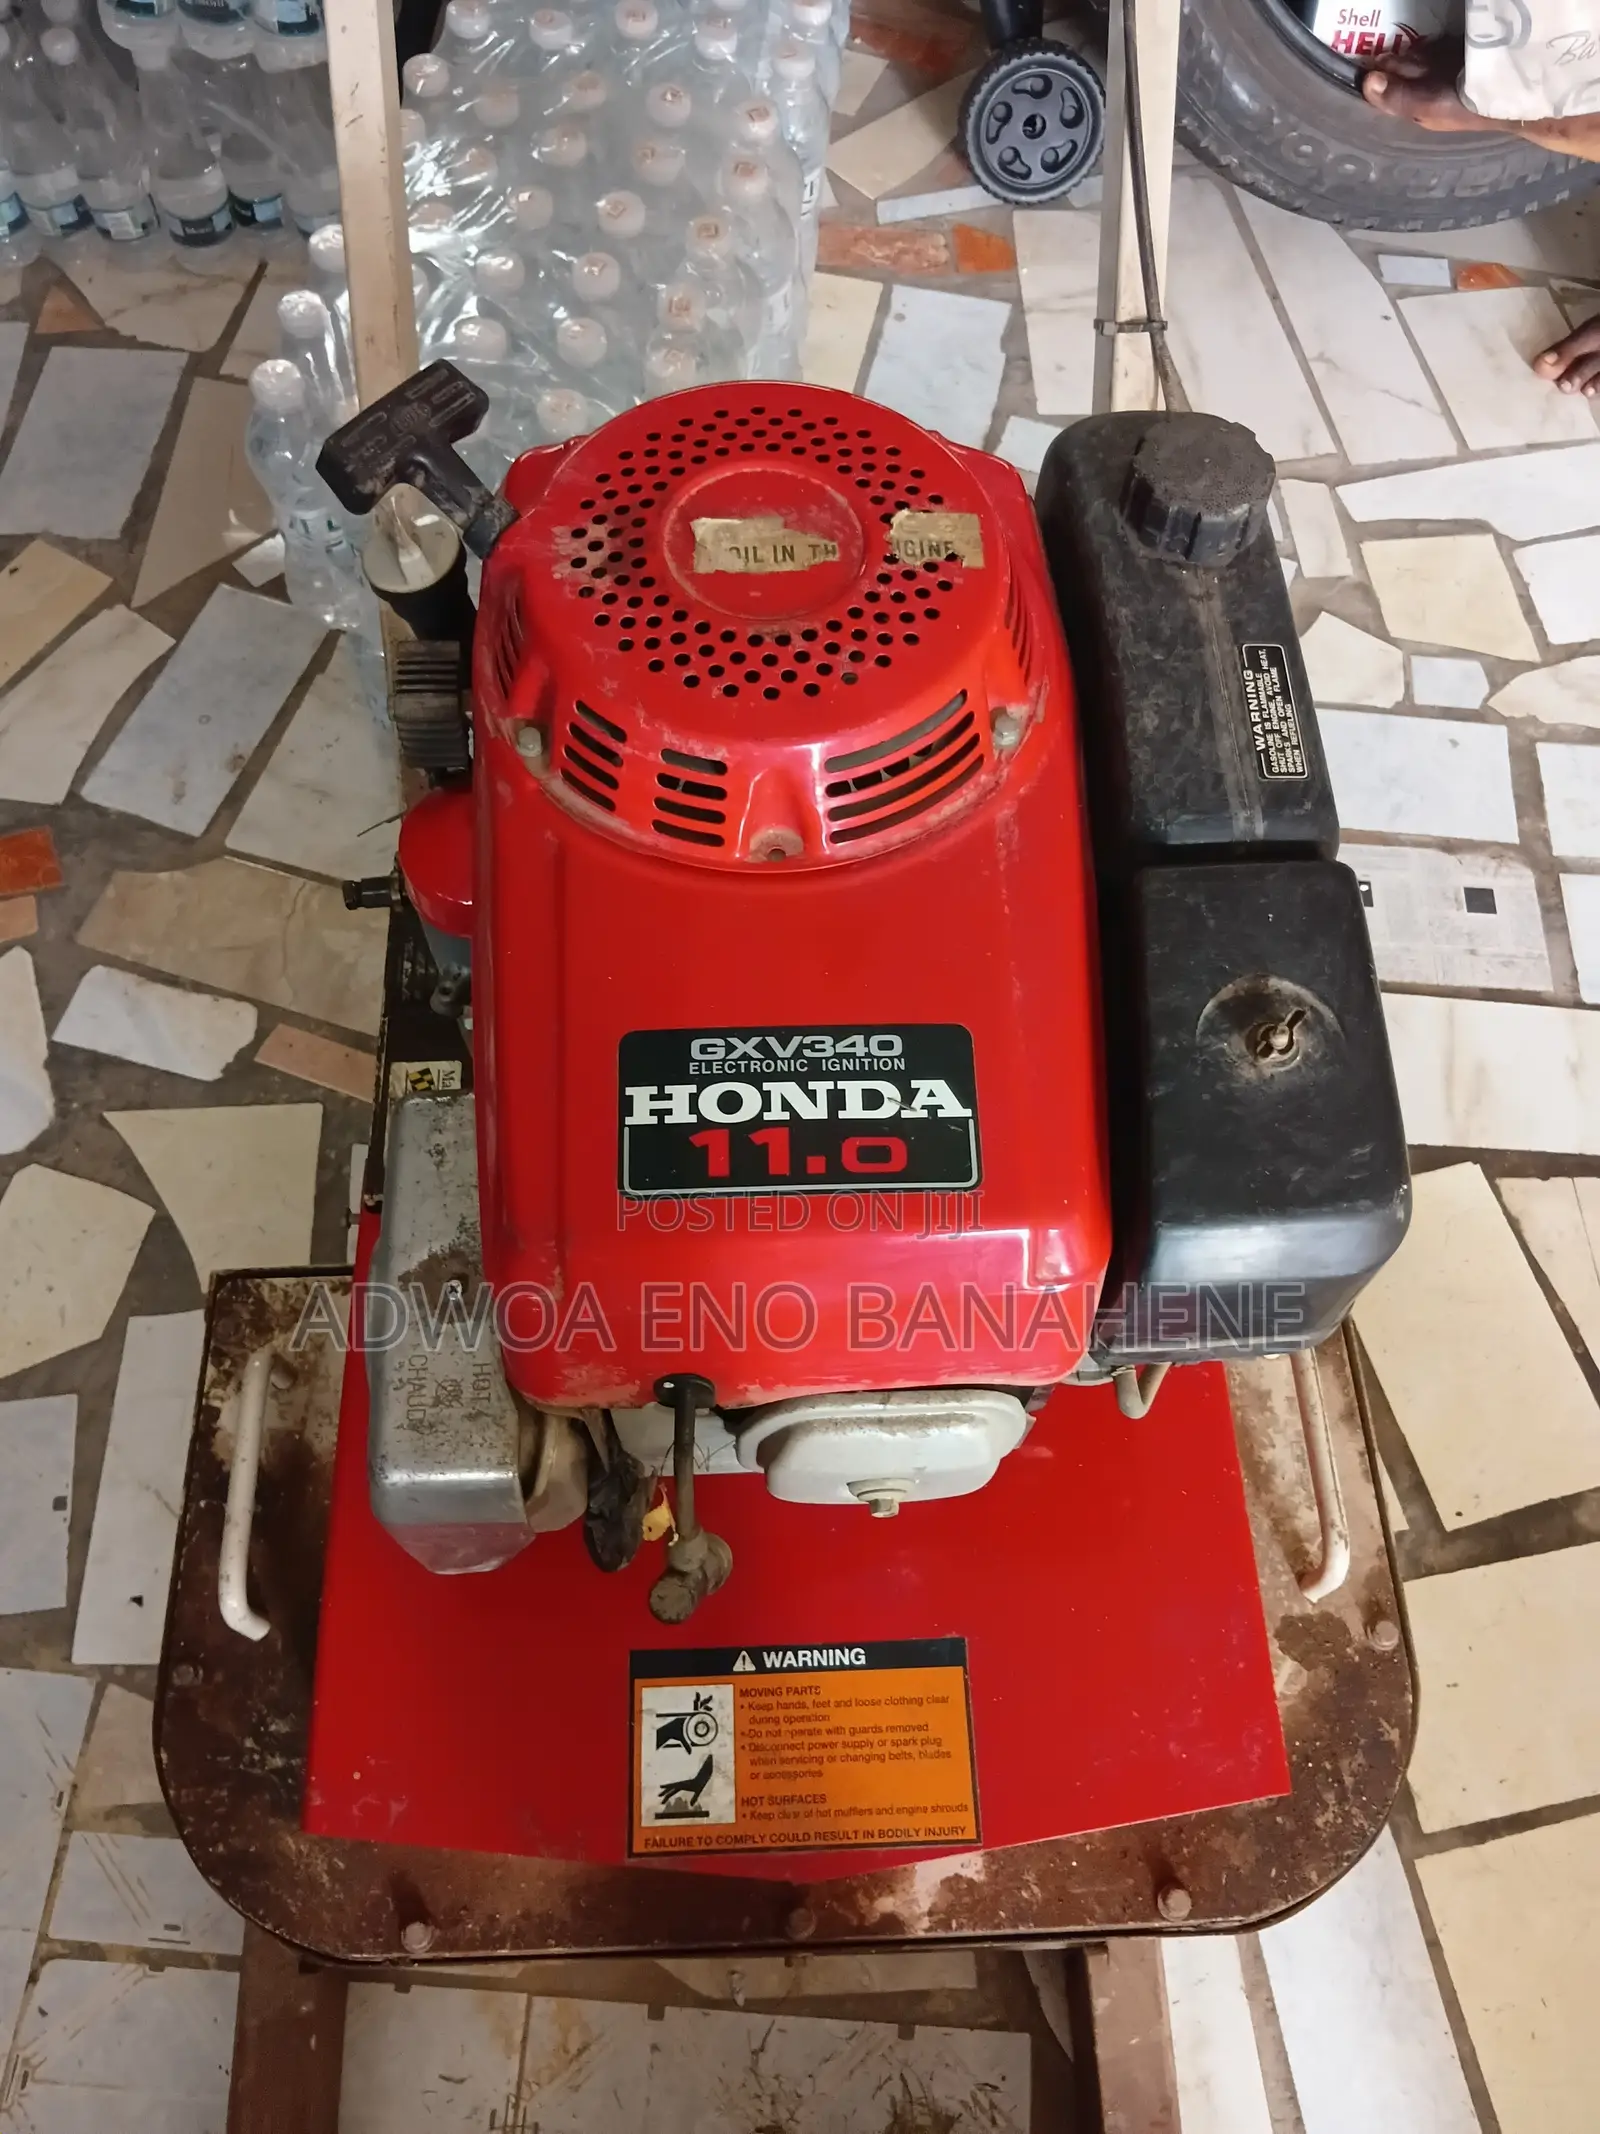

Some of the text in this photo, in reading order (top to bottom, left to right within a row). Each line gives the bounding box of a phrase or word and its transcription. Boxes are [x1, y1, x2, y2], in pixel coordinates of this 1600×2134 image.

[1337, 8, 1381, 27] Shell
[773, 544, 795, 563] IN
[1263, 672, 1273, 696] AVOID
[1243, 670, 1266, 751] WARNING
[1270, 667, 1295, 773] SPARKS AND OPEN FLAME
[1255, 672, 1279, 773] GASOLINE IS FLAMMABLE
[1274, 733, 1282, 748] OFF
[1286, 704, 1303, 773] WHEN REFUELING
[1277, 752, 1287, 773] SHUT
[690, 1034, 903, 1060] GXV340
[689, 1058, 905, 1075] ELECTRONIC IGNITION
[625, 1079, 972, 1125] HONDA
[689, 1127, 908, 1178] 11.0
[406, 1354, 428, 1421] CHAUD
[472, 1363, 491, 1403] HOT
[763, 1647, 866, 1668] WARNING
[740, 1685, 821, 1698] MOVING PARTS
[748, 1694, 949, 1712] Keep hands, feet and loose clothing clear
[749, 1713, 830, 1726] during operation
[748, 1728, 763, 1739] Do
[766, 1728, 781, 1737] not
[826, 1726, 846, 1735] with
[849, 1724, 884, 1736] guards
[886, 1722, 929, 1732] removed
[808, 1740, 840, 1751] power
[841, 1739, 875, 1750] supply
[877, 1739, 887, 1748] or
[890, 1736, 918, 1748] spark
[921, 1736, 943, 1748] plug
[780, 1755, 824, 1766] servicing
[827, 1755, 837, 1763] or
[840, 1752, 886, 1764] changing
[889, 1751, 916, 1762] belts,
[750, 1772, 761, 1780] or
[741, 1794, 827, 1807] HOT SURFACES
[749, 1811, 775, 1822] Keep
[804, 1808, 814, 1819] of
[816, 1807, 832, 1817] hot
[834, 1806, 873, 1817] mufflers
[876, 1804, 894, 1815] and
[896, 1804, 929, 1817] engine
[931, 1802, 969, 1813] shrouds
[644, 1826, 967, 1849] FAILURE TO COMPLY COULD RESULT IN BODILY INJURY
